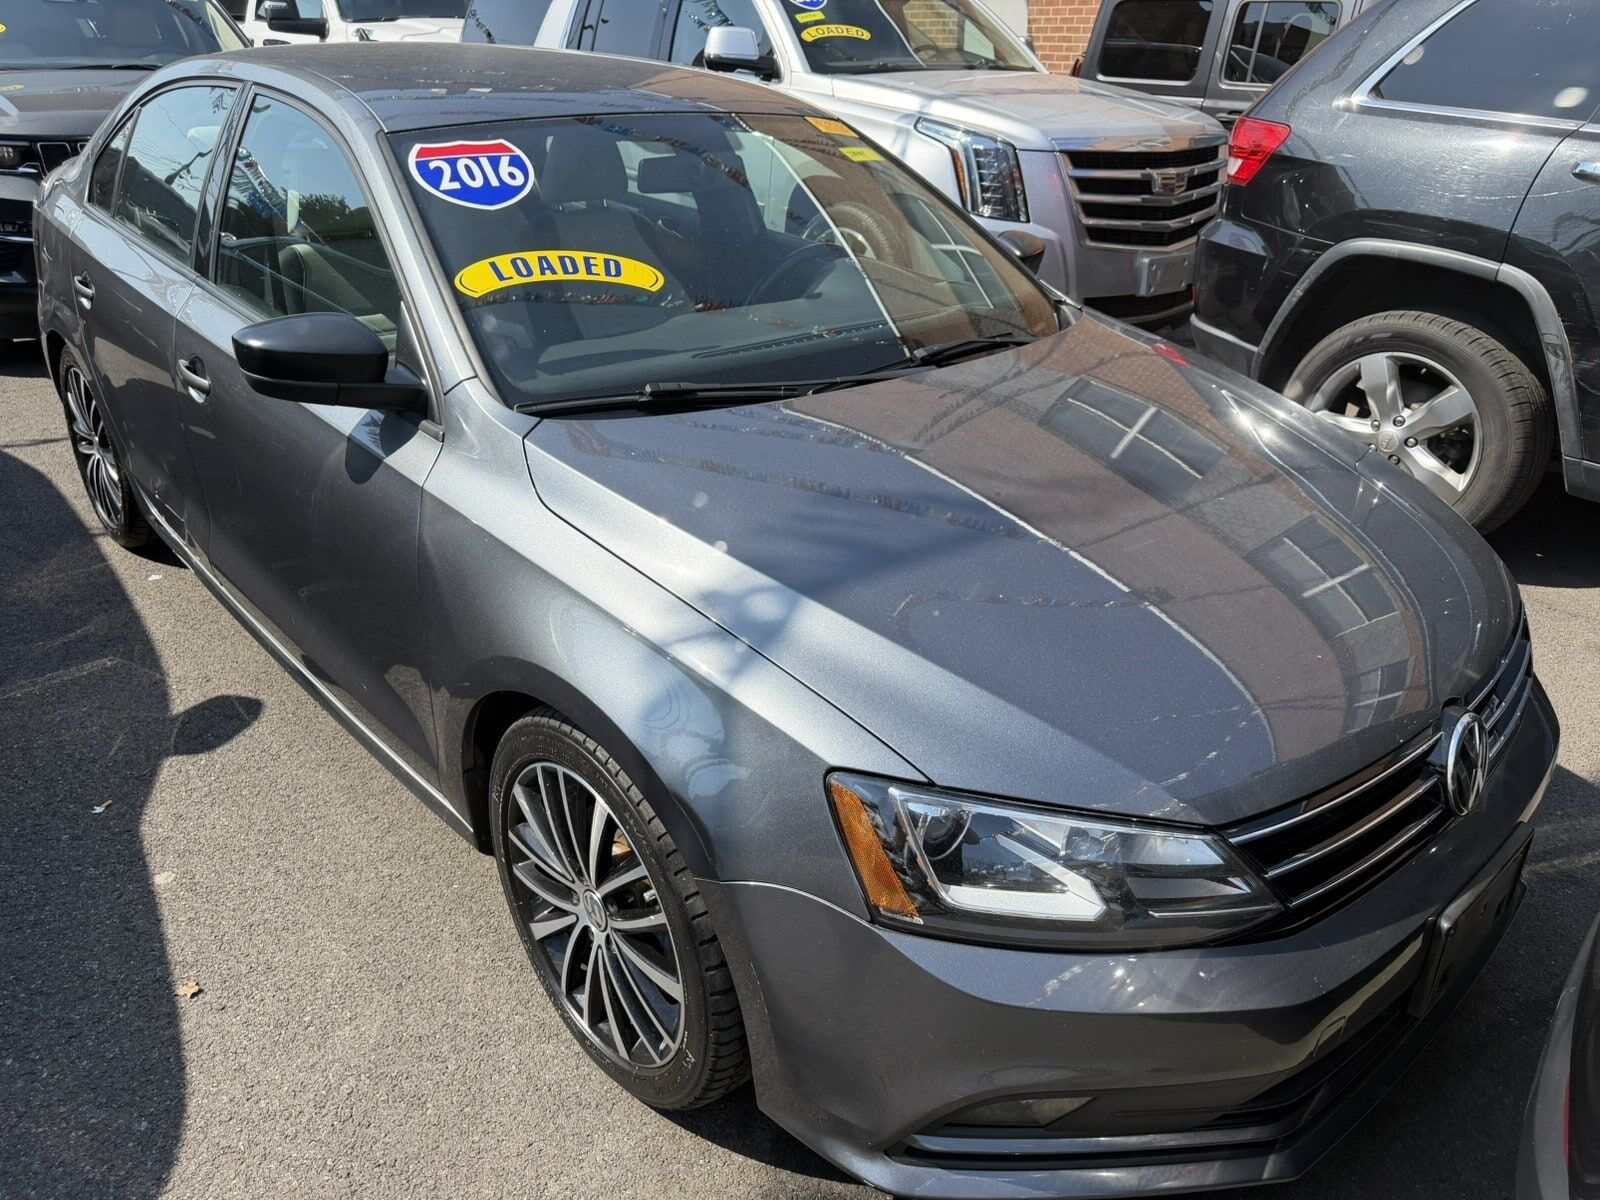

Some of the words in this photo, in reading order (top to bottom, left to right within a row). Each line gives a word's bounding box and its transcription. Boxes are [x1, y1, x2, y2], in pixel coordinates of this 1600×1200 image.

[806, 26, 864, 38] LOADED
[428, 155, 526, 191] 2016
[488, 255, 623, 282] LOADED
